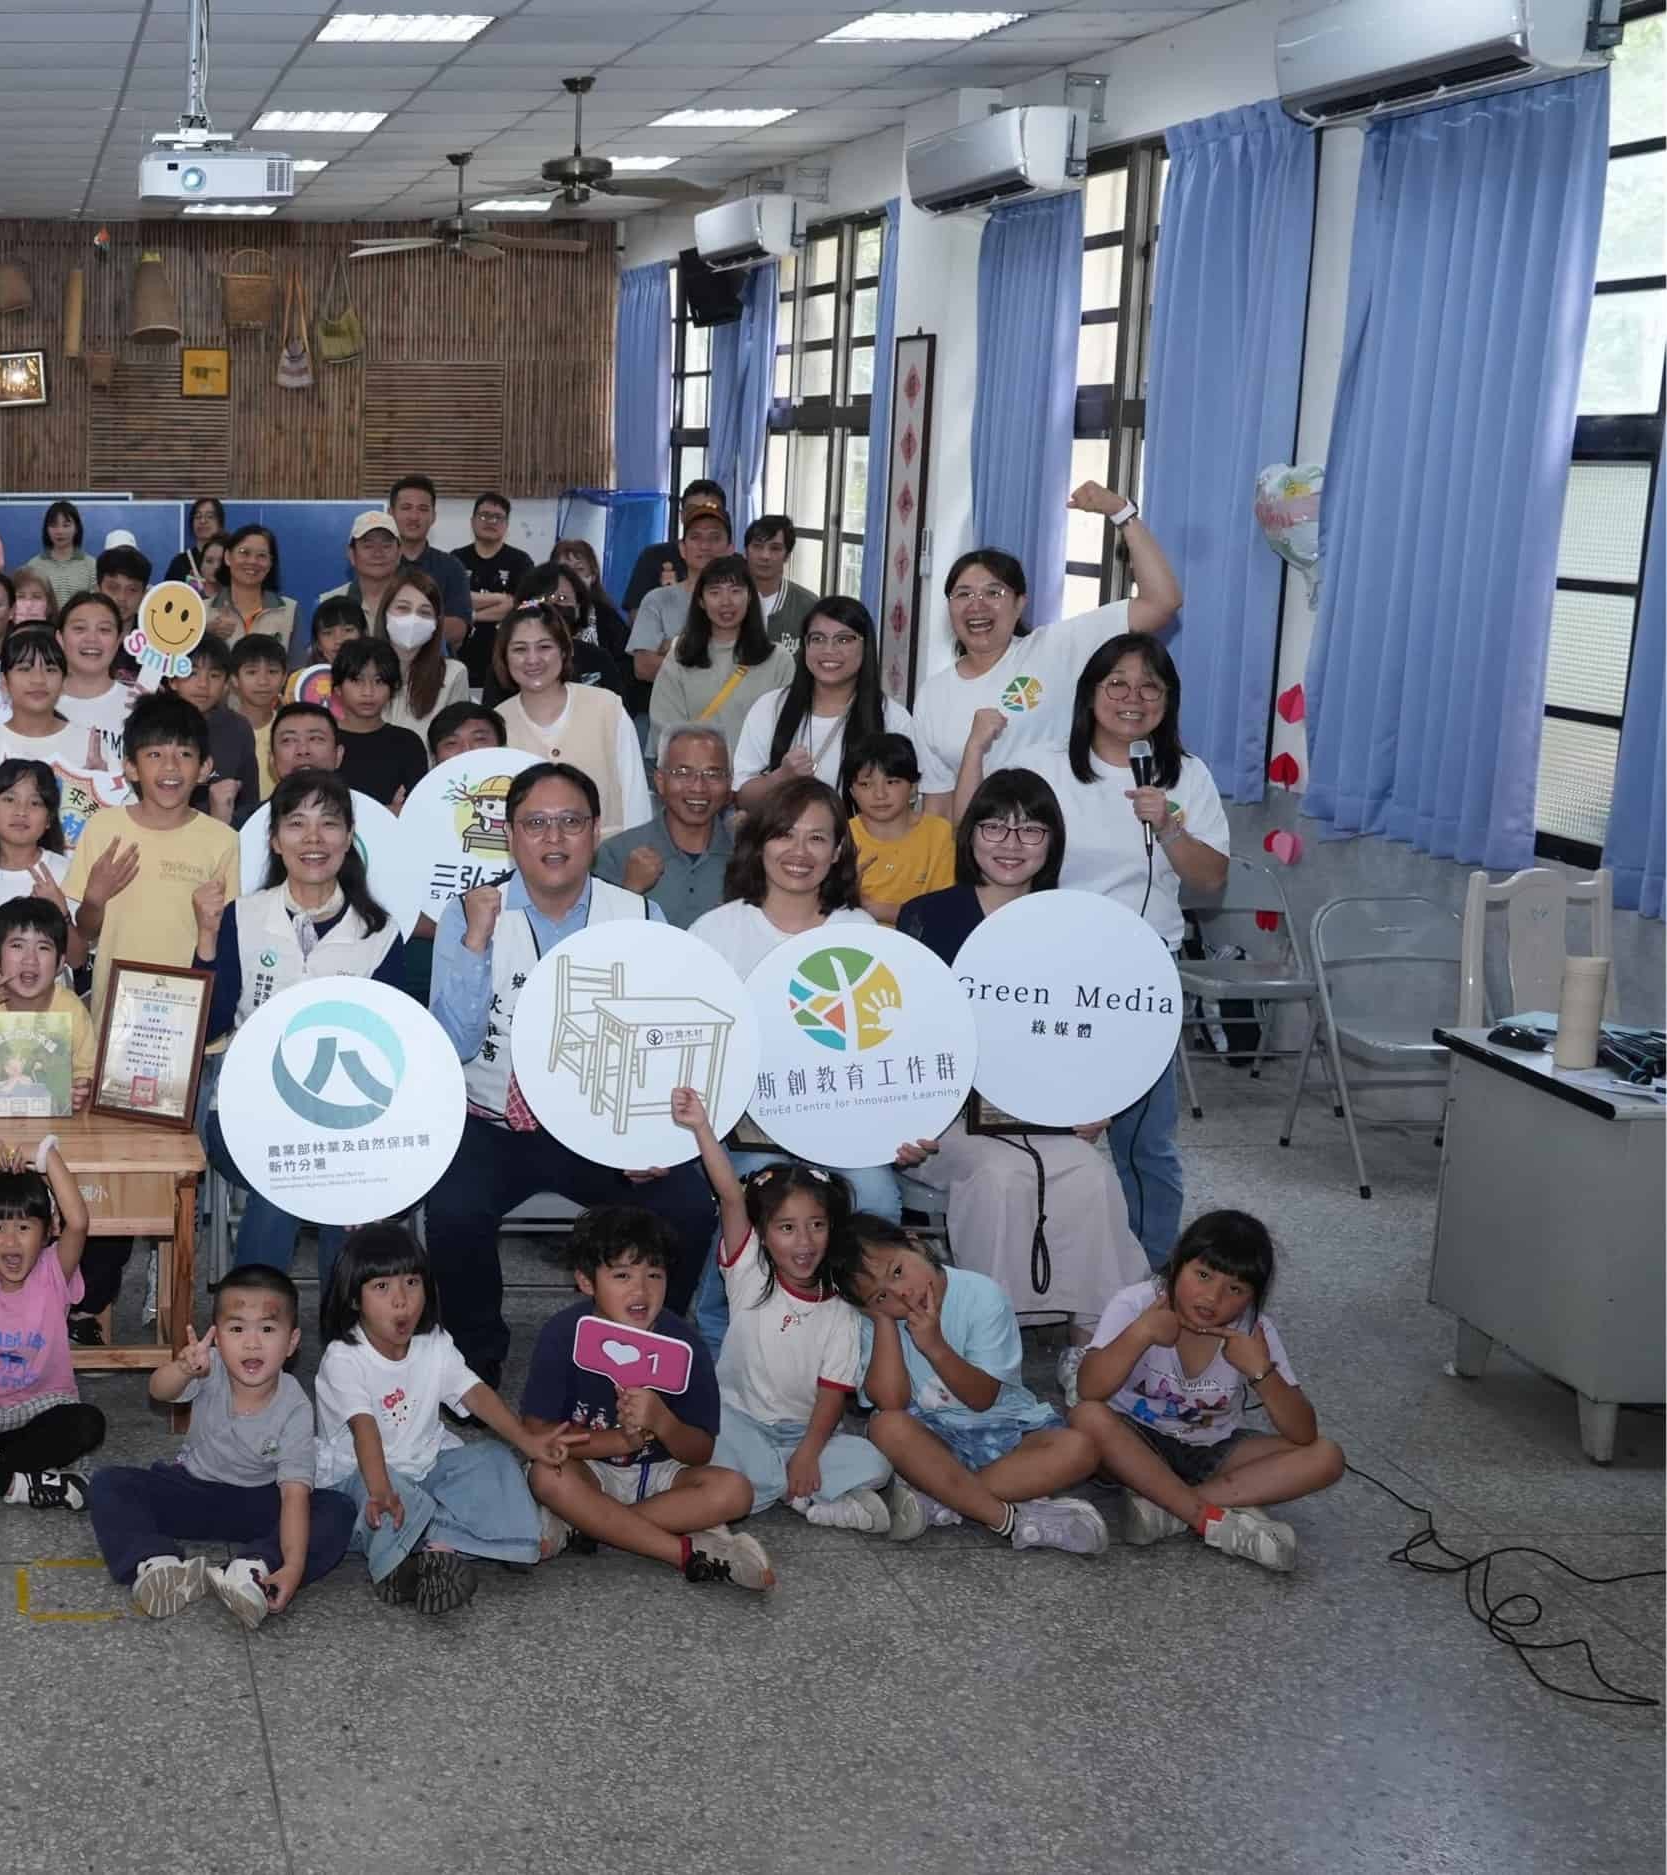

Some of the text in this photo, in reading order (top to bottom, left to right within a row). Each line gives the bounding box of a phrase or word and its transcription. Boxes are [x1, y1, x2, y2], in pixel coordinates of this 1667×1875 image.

[128, 632, 190, 676] Smile
[1074, 984, 1175, 1015] Media
[1030, 1018, 1093, 1039] 綠媒體
[795, 1101, 832, 1114] Centre
[835, 1097, 850, 1110] for
[854, 1092, 909, 1107] Innovative
[912, 1086, 961, 1101] Learning
[268, 1157, 327, 1174] 新竹分署
[647, 1353, 659, 1375] 1
